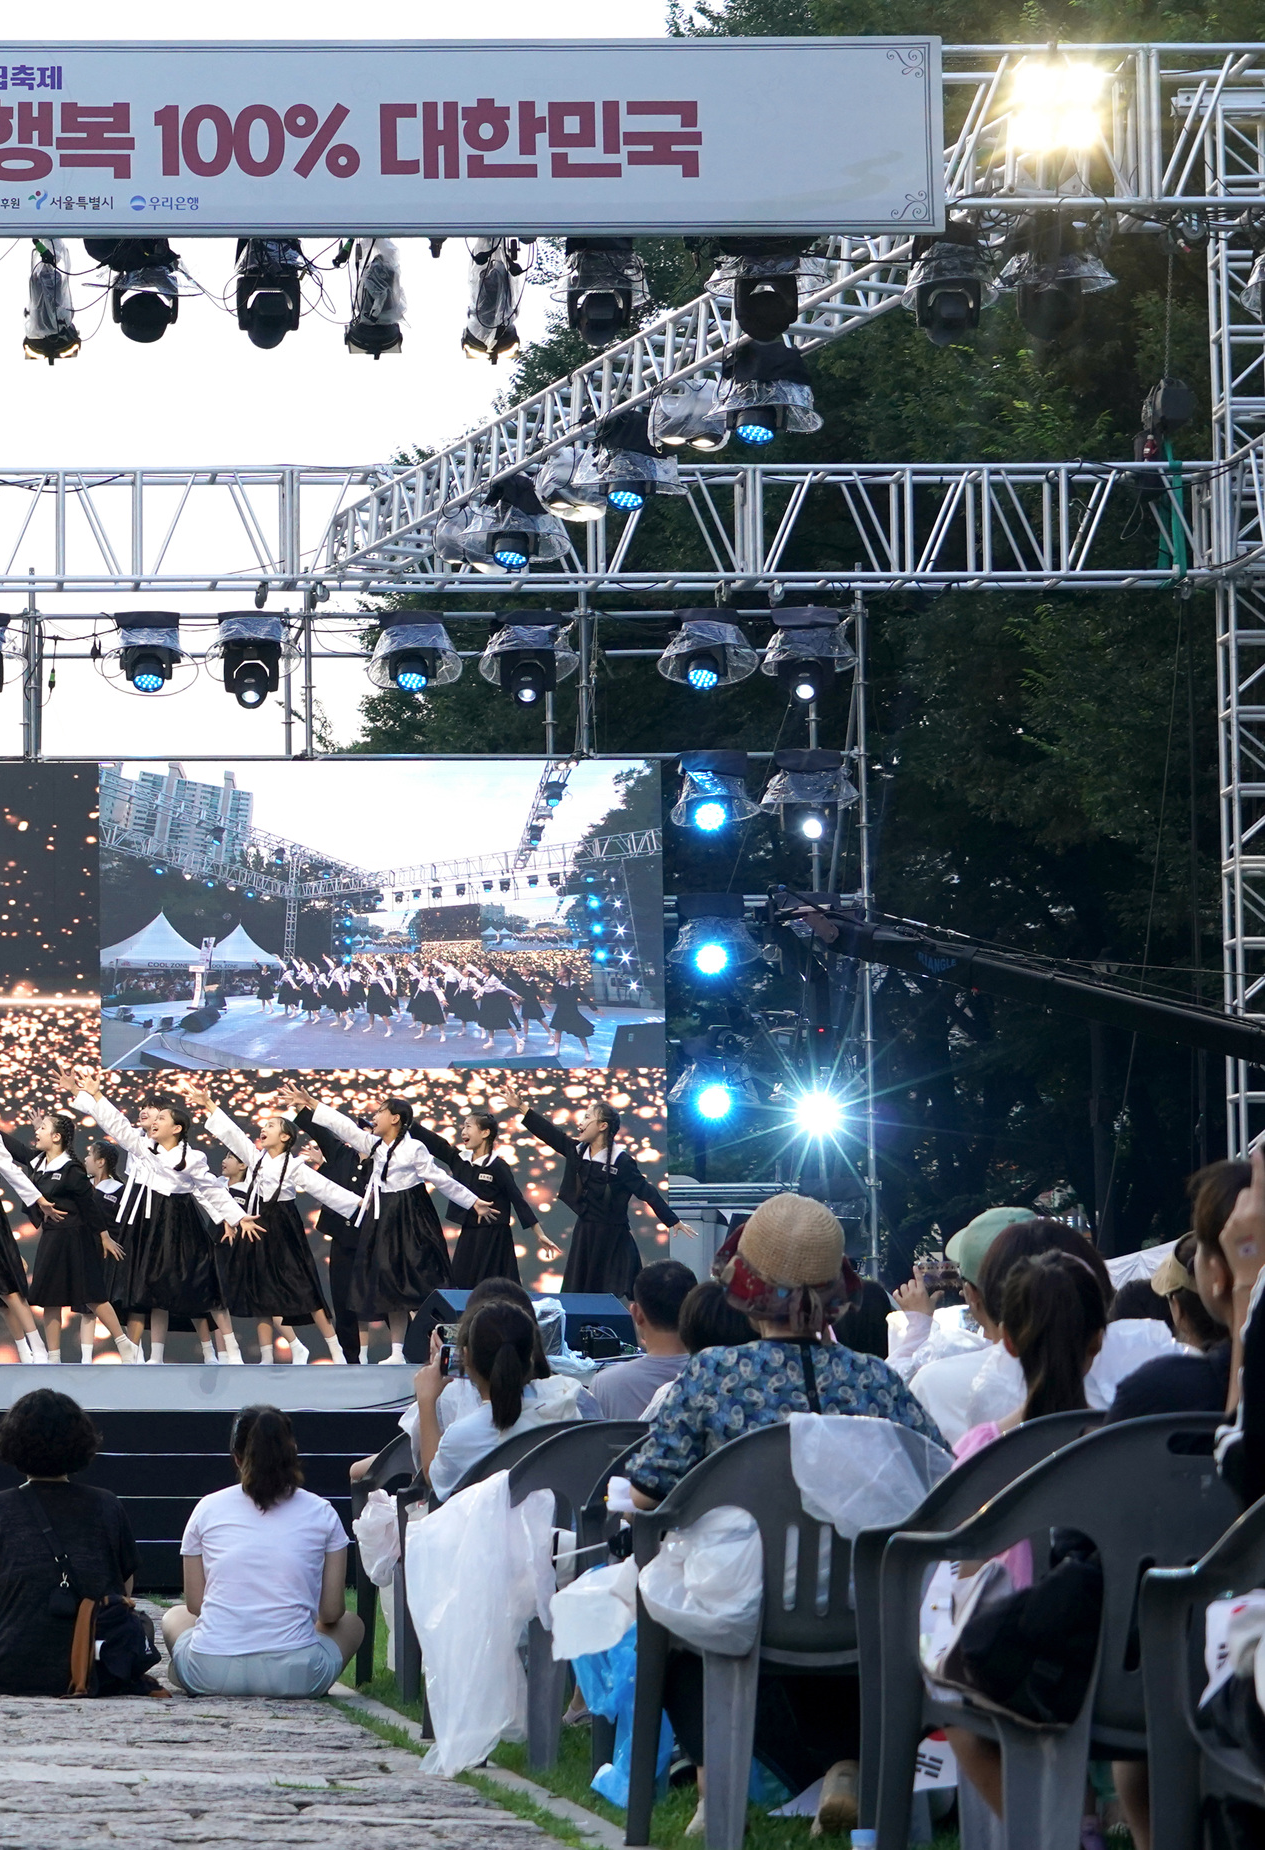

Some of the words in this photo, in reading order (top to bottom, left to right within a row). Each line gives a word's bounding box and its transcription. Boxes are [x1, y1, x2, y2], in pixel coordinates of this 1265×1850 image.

[153, 102, 361, 180] 100%
[379, 97, 703, 180] 대한민국
[0, 197, 20, 210] 후원
[49, 195, 114, 211] 서울특별시
[148, 196, 200, 212] 우리은행
